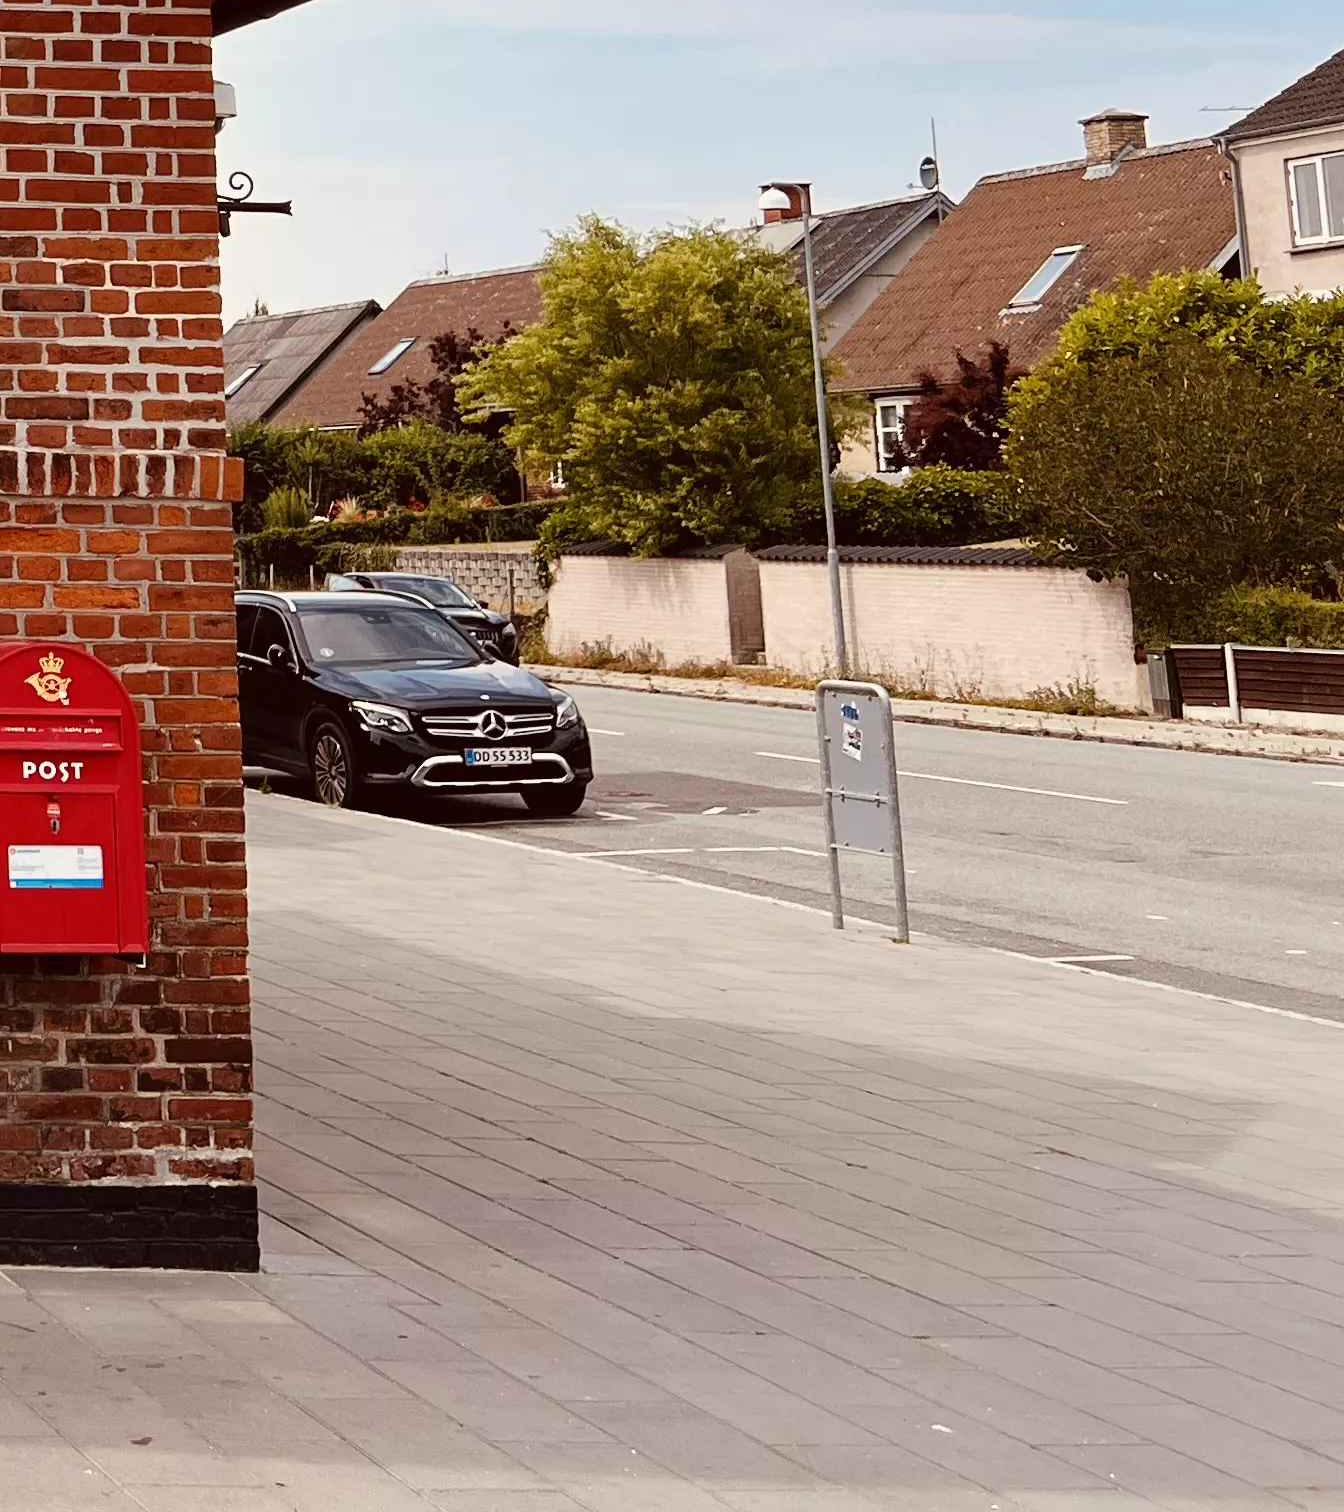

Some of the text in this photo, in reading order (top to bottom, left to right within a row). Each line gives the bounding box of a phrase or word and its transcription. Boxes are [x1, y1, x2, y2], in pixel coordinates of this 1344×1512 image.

[474, 750, 529, 762] DD 55 533
[22, 761, 84, 782] POST
